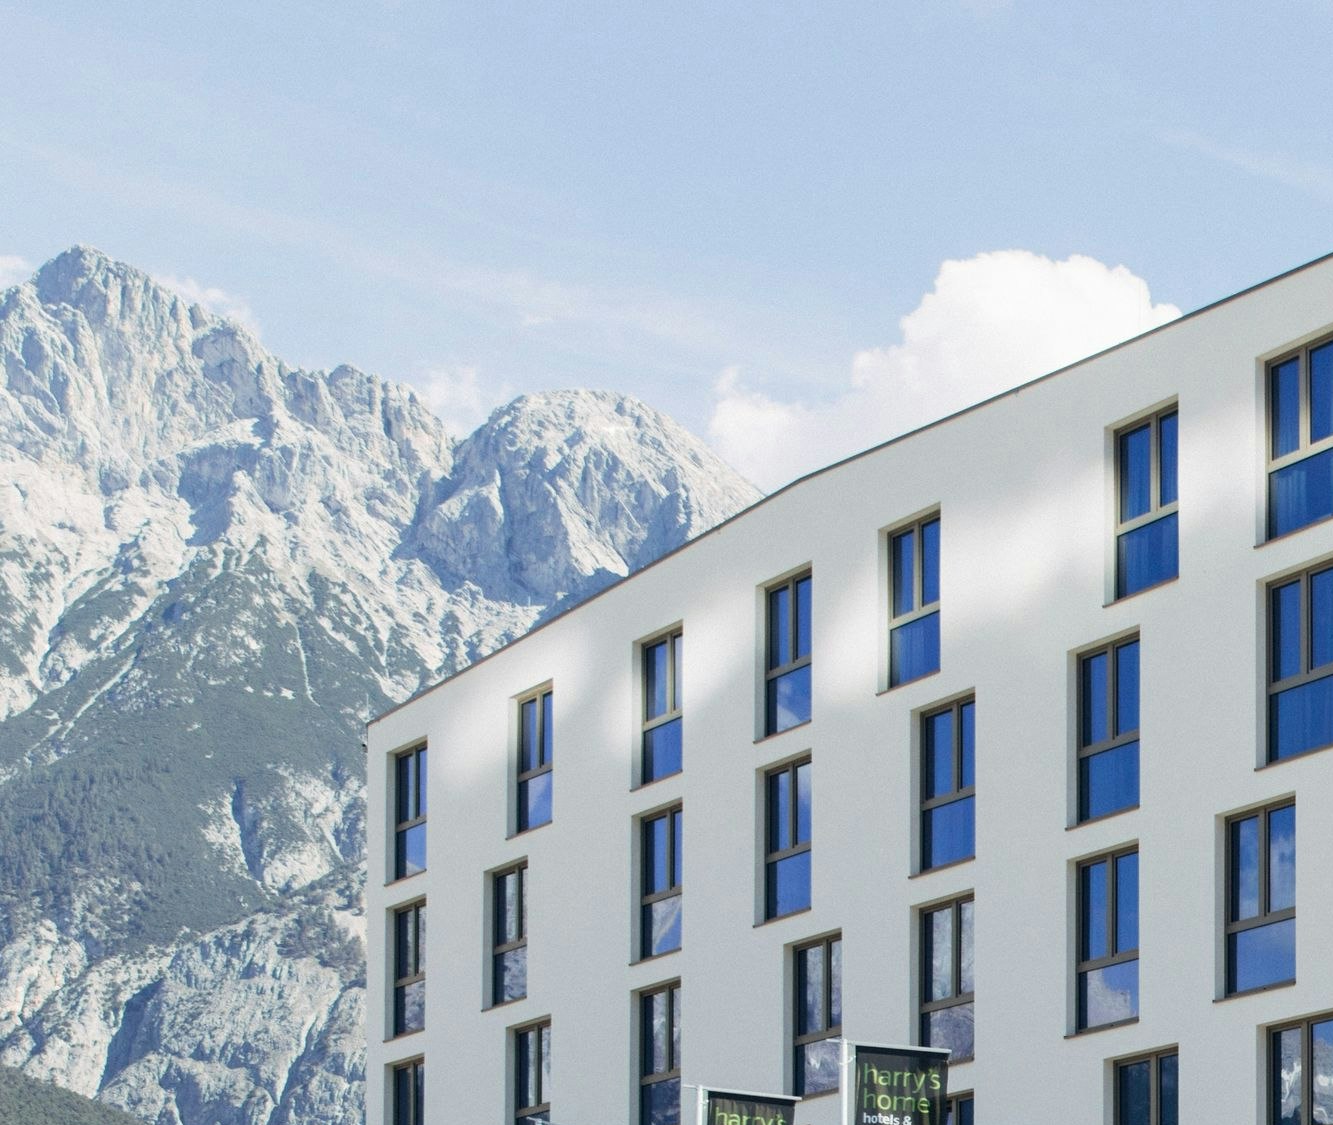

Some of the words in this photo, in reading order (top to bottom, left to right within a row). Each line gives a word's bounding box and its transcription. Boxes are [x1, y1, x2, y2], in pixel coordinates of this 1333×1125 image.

[864, 1063, 941, 1093] harry's
[863, 1088, 930, 1113] home
[863, 1112, 900, 1125] hotels
[903, 1116, 912, 1125] &
